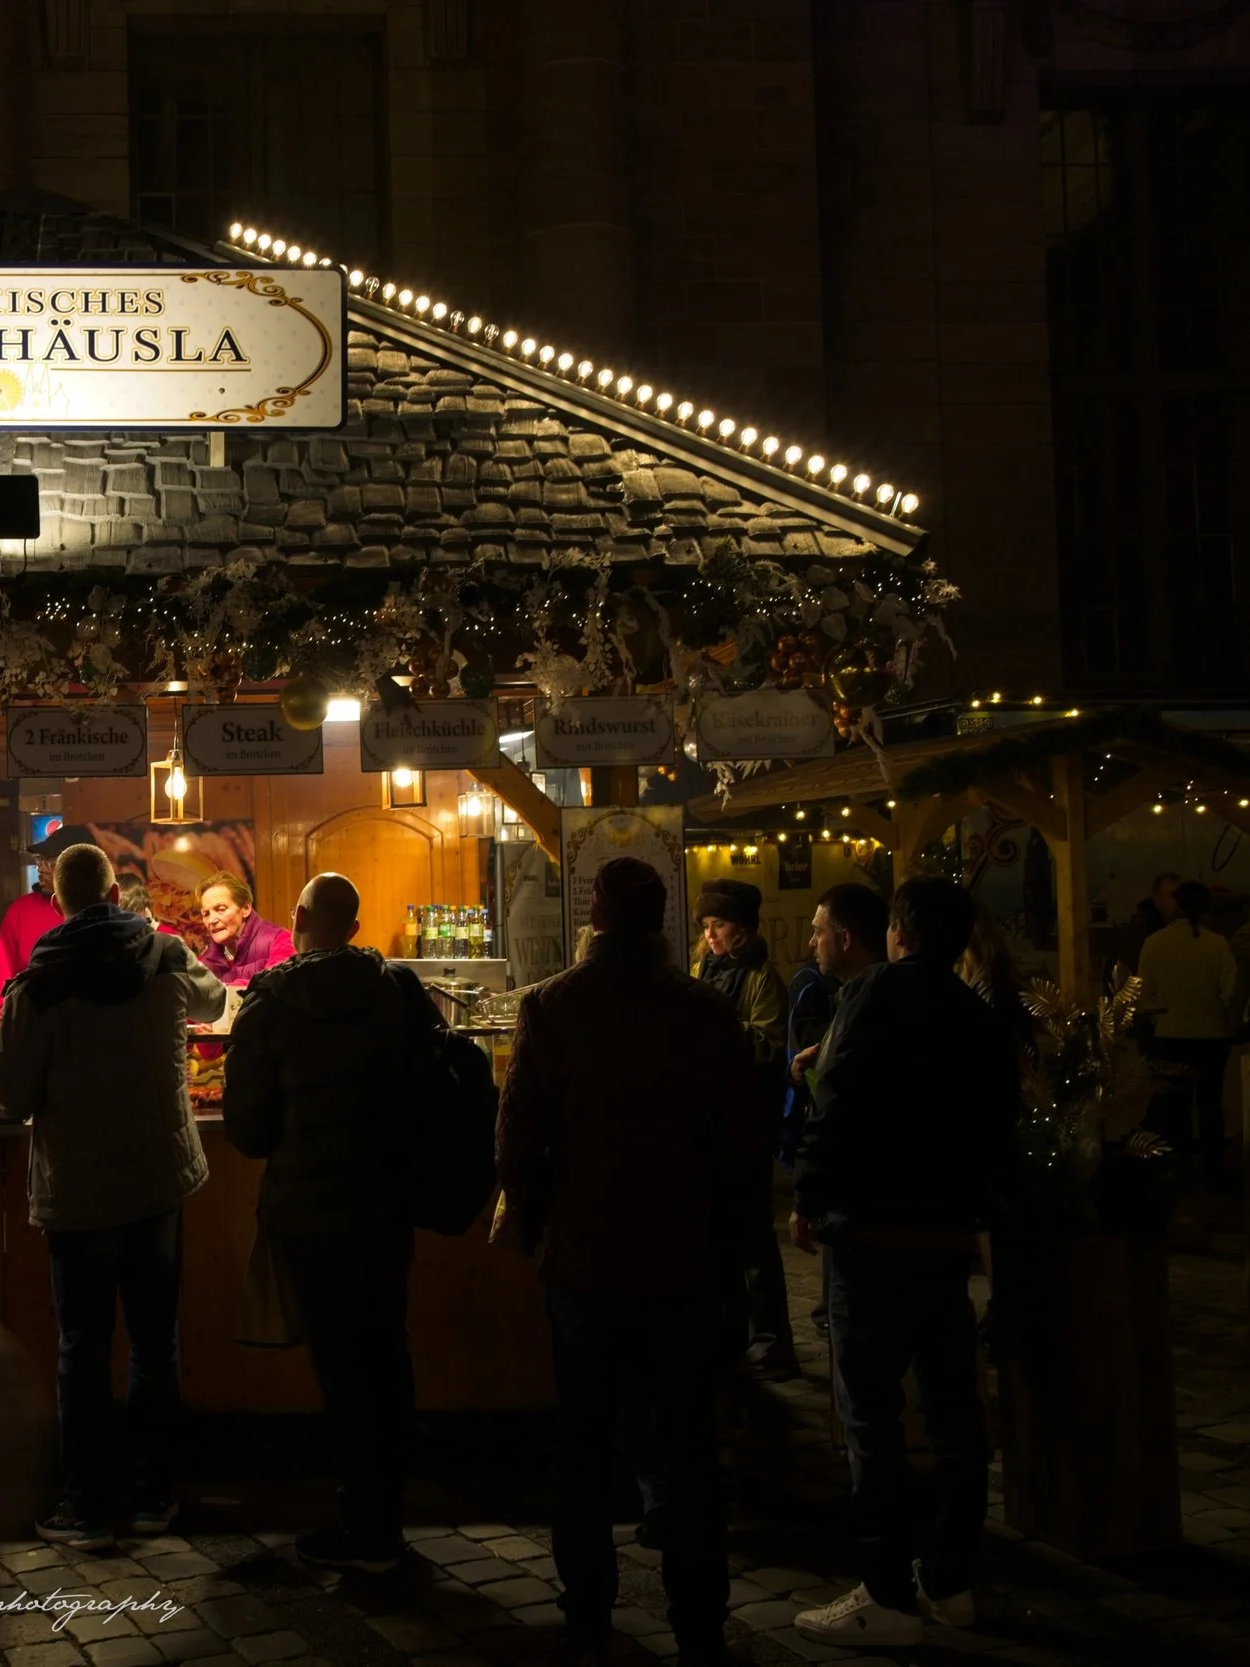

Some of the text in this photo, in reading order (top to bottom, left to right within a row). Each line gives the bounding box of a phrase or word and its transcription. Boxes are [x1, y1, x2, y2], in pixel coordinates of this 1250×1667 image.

[222, 720, 285, 743] Steak
[554, 717, 656, 735] Rindswurst
[25, 727, 129, 745] 2 Fränkische
[49, 752, 61, 761] im
